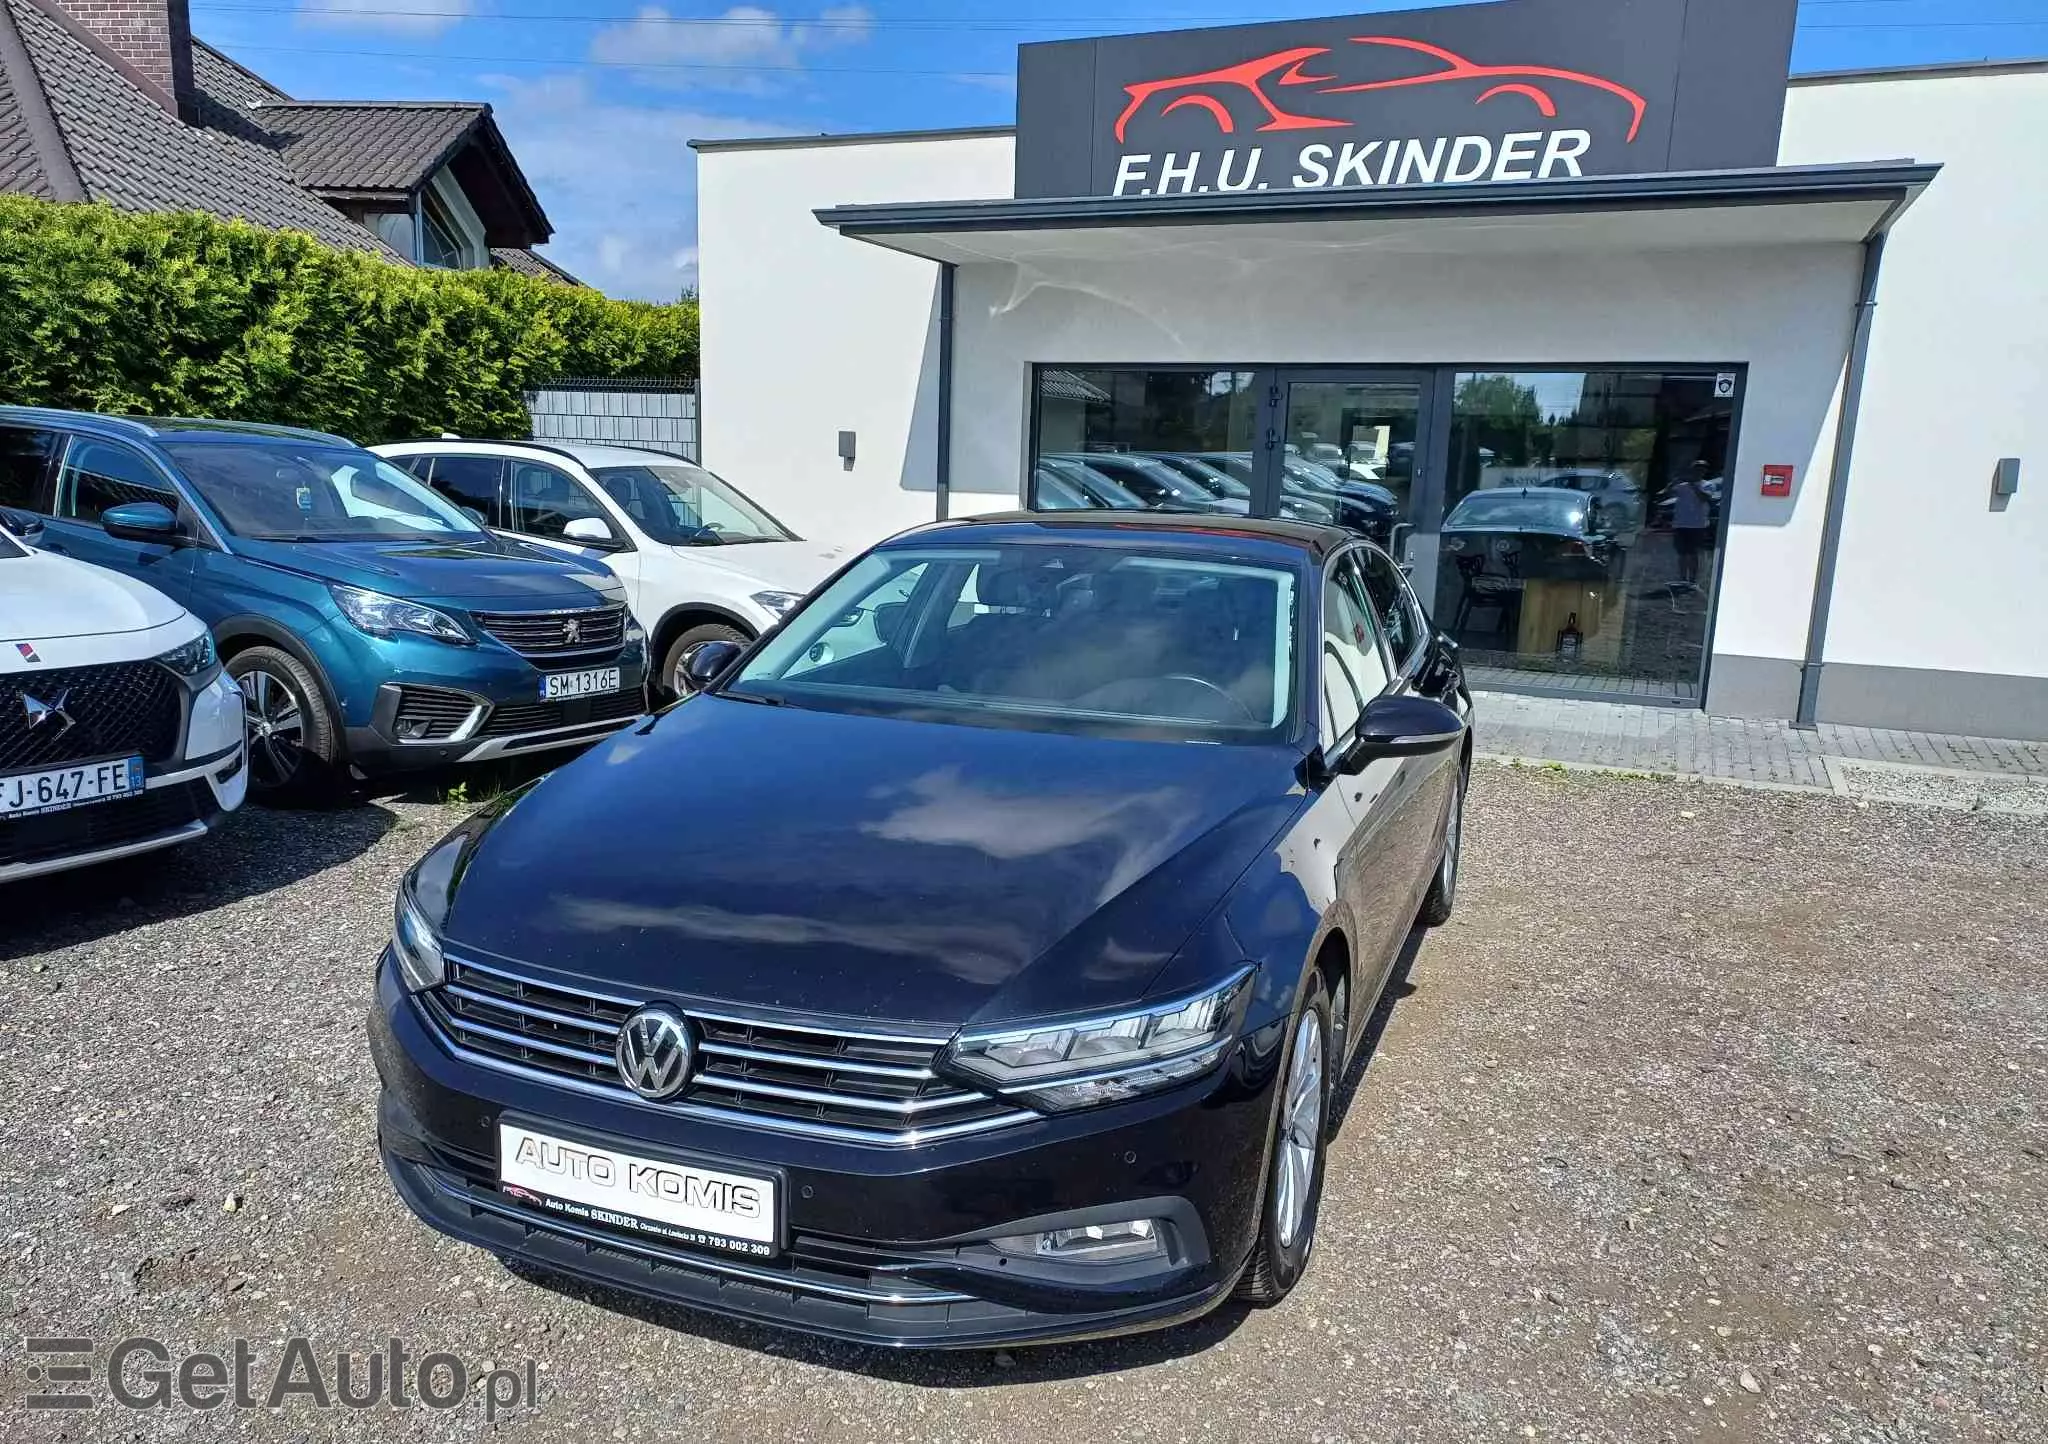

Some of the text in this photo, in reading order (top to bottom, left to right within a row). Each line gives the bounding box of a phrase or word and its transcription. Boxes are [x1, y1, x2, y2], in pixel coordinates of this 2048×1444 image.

[1112, 129, 1591, 197] F.H.U. SKINDER
[515, 1137, 760, 1219] AUTO KOMIS
[545, 1198, 770, 1256] Auto Komis SKINDER 793 002 309
